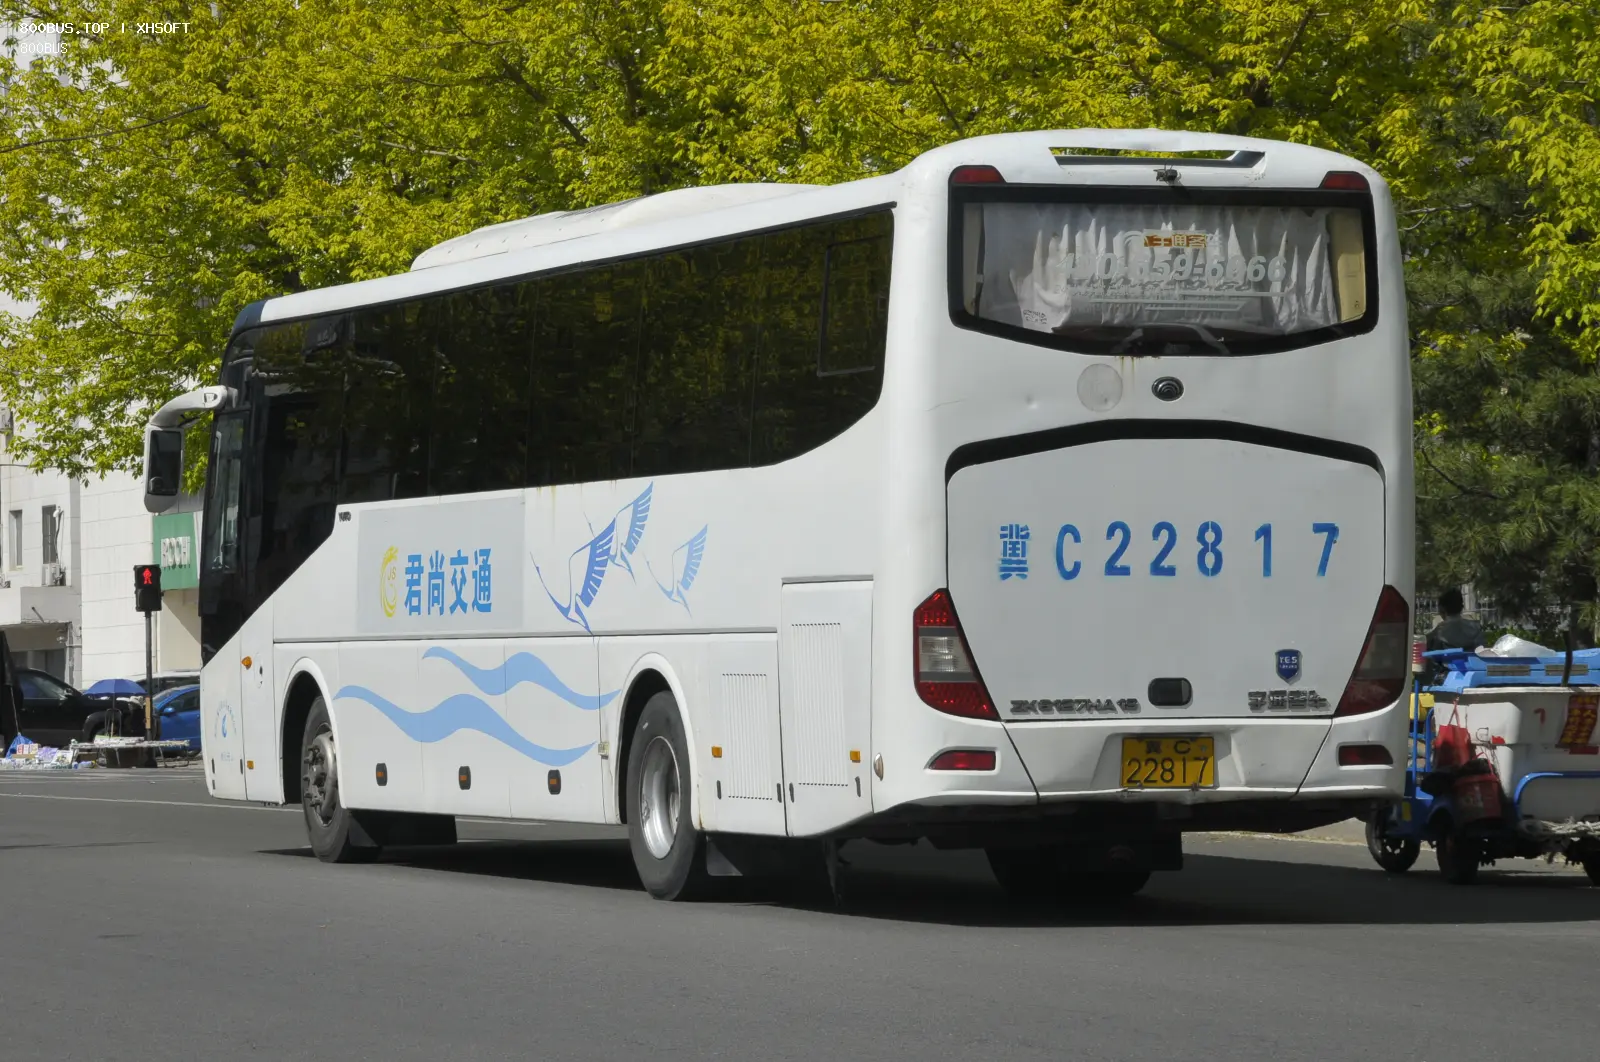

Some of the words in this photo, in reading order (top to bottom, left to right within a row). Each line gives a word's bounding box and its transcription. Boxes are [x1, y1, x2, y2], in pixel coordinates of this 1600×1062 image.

[404, 548, 492, 616] 君尚交通
[1126, 757, 1209, 784] 22817
